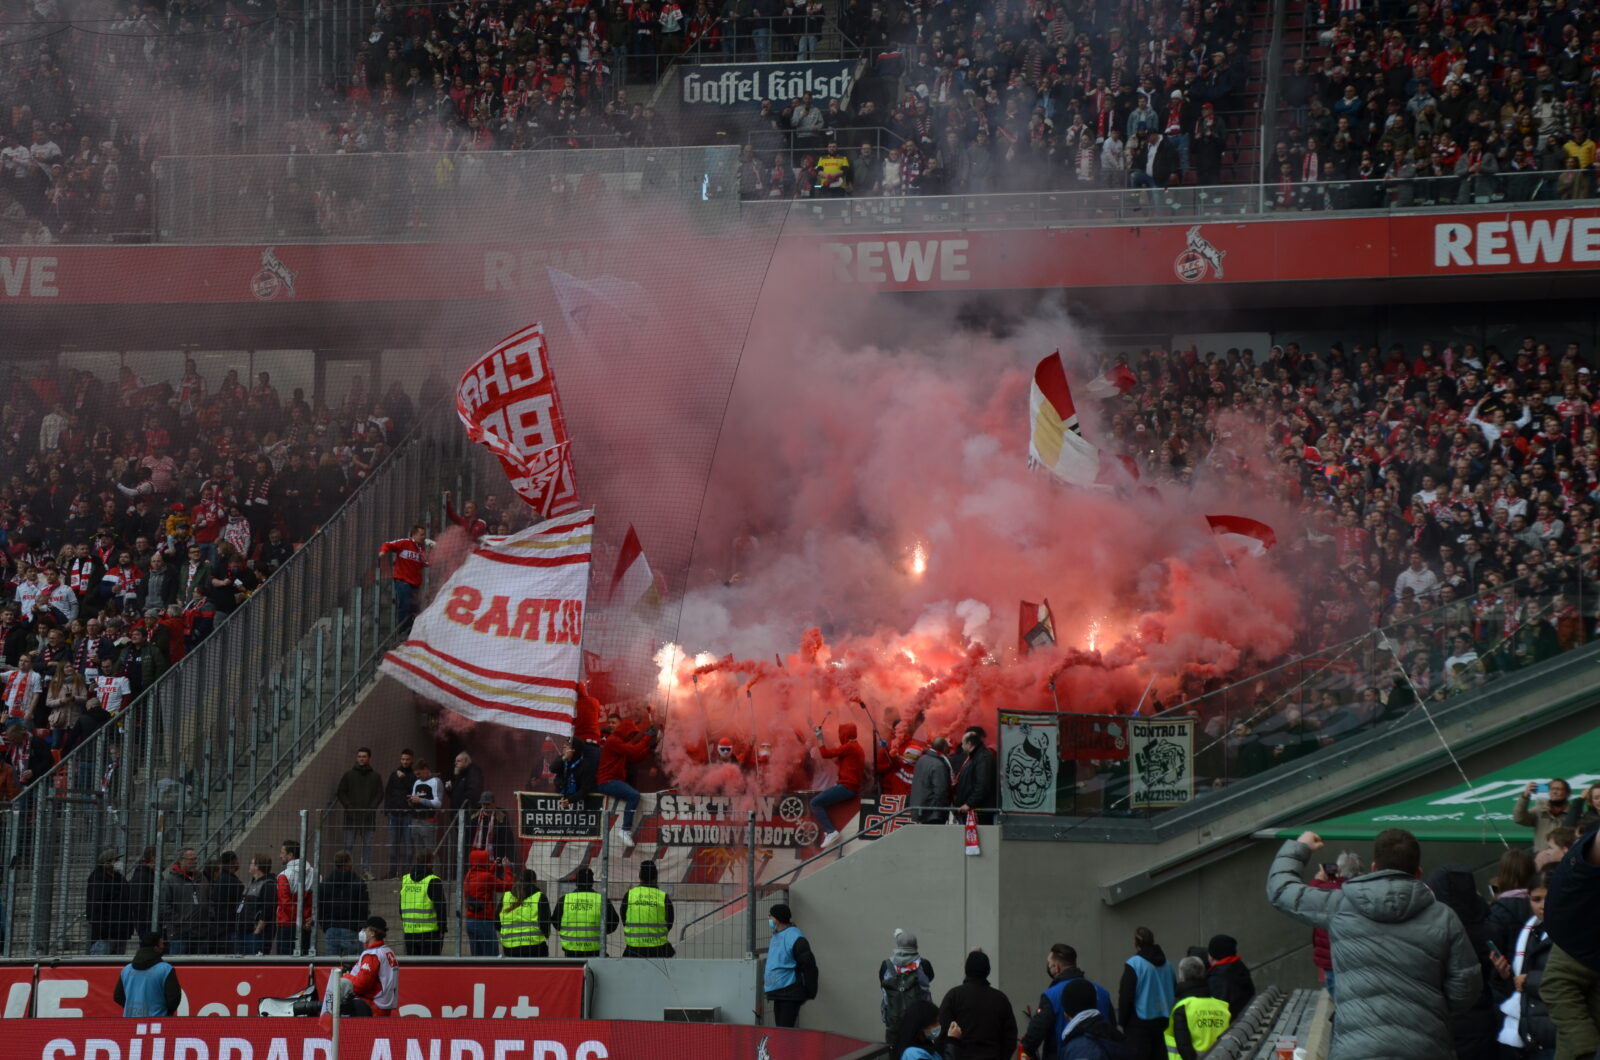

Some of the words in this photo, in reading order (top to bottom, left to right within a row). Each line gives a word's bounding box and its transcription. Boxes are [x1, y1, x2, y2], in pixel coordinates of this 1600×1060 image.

[683, 71, 764, 105] Gaffel
[1434, 217, 1600, 267] REWE
[822, 240, 971, 283] REWE
[1133, 726, 1176, 738] CONTRO
[1178, 726, 1188, 737] IL
[1135, 790, 1188, 803] RAZZISMO
[526, 813, 597, 826] PARADISO
[1196, 1018, 1225, 1029] ORDNER
